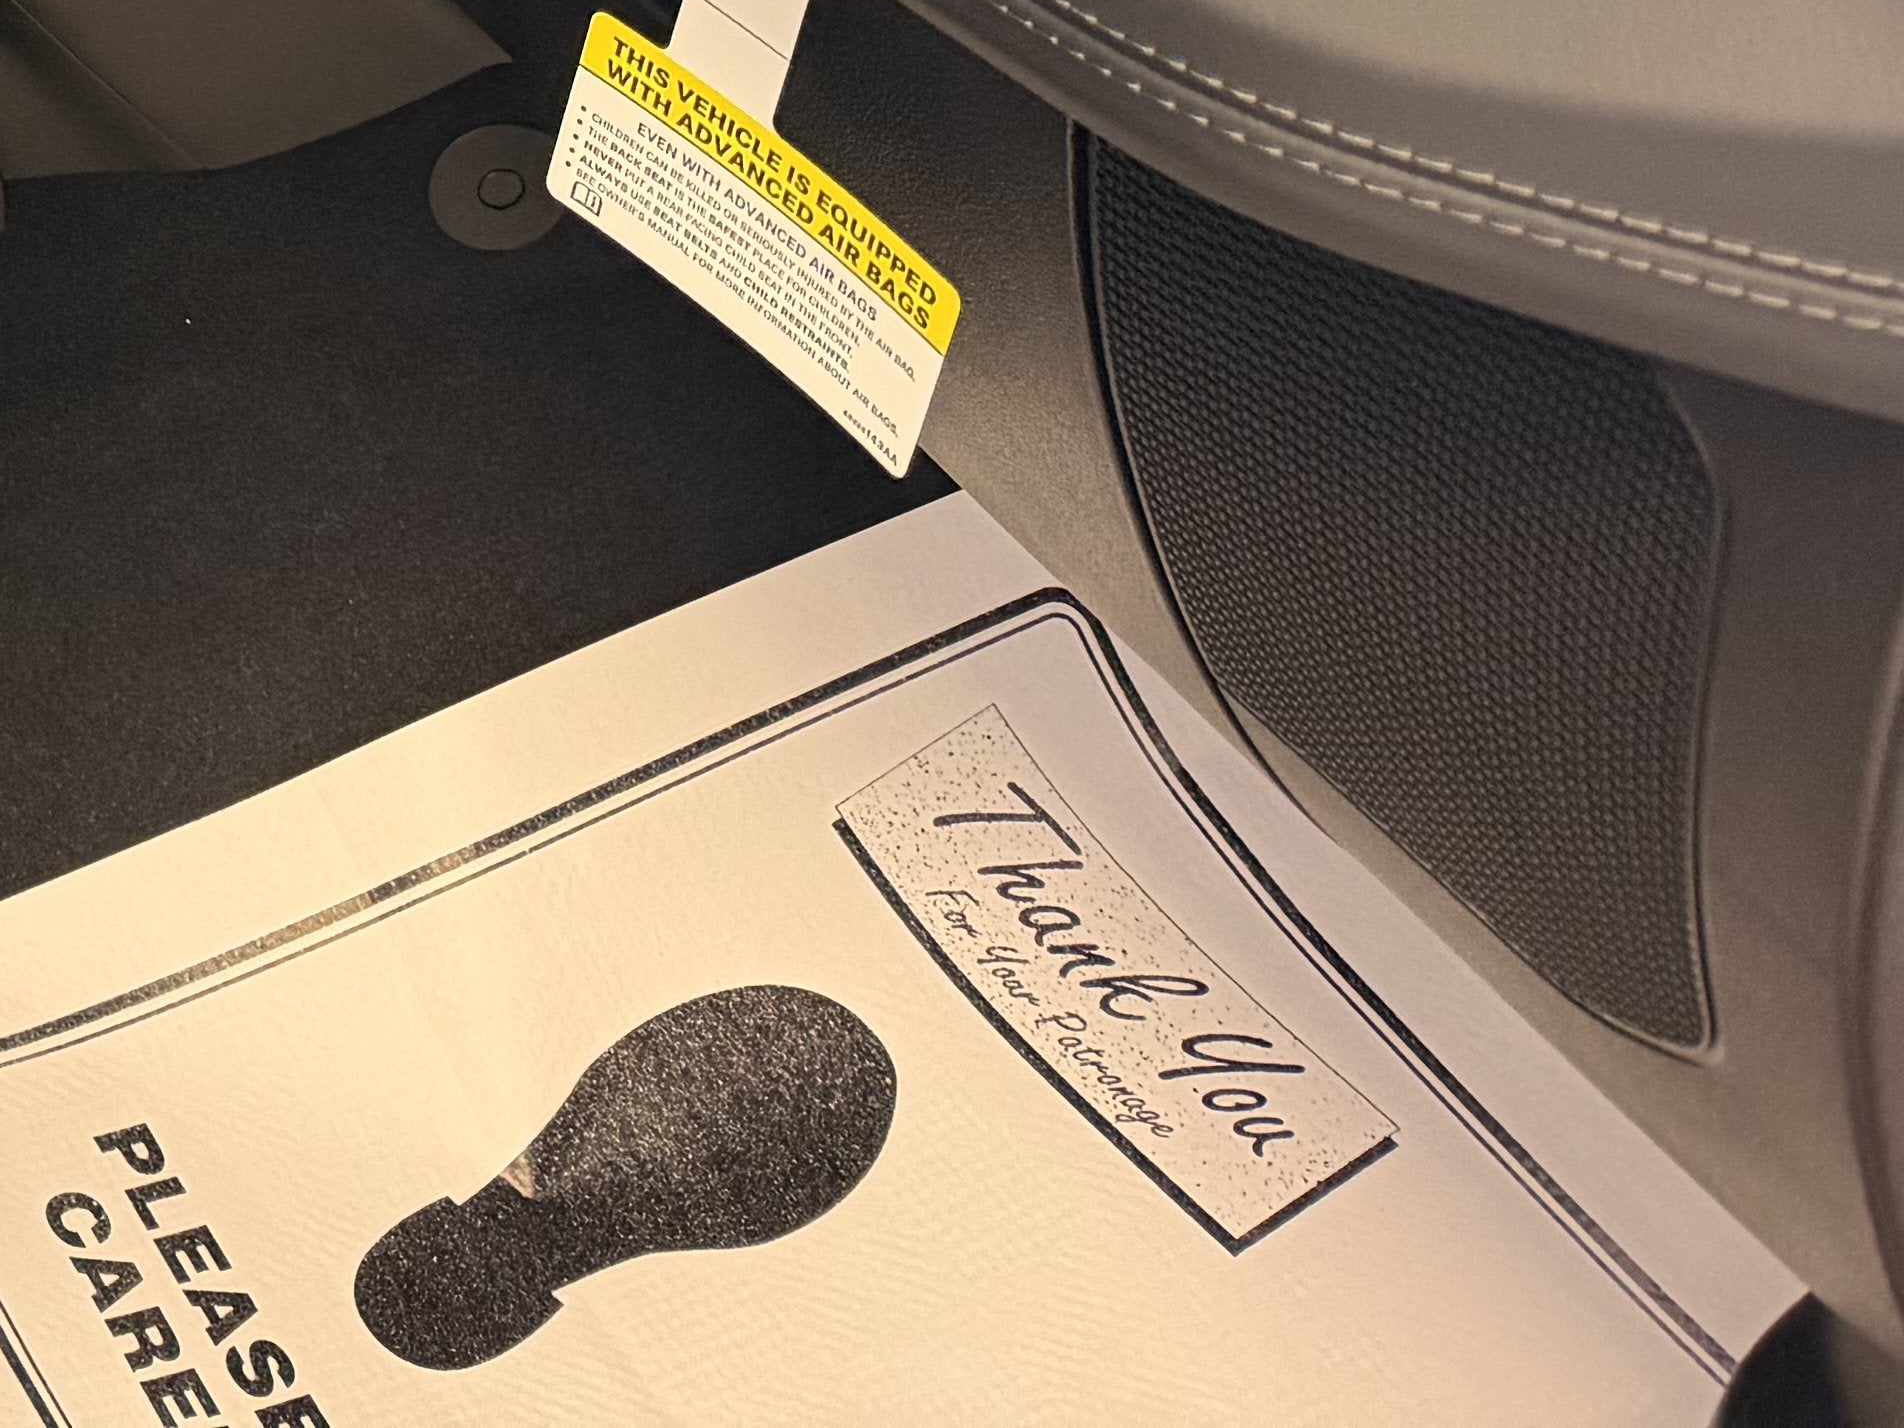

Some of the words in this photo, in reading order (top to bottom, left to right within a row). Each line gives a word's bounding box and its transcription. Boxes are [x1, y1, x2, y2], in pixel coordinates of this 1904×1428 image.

[576, 168, 596, 187] SEE
[647, 218, 691, 257] MANUAL
[693, 253, 713, 274] FOR
[715, 270, 746, 300] MORE
[747, 296, 816, 360] INFORMATION
[817, 357, 851, 390] ABOUT
[852, 388, 869, 409] AIR
[580, 155, 628, 193] ALWAYS
[630, 189, 651, 210] USE
[653, 206, 682, 232] SEAT
[684, 229, 718, 260] BELTS
[719, 258, 742, 279] AND
[744, 276, 779, 309] CHILD
[584, 140, 623, 172] NEVER
[624, 168, 645, 188] PUT
[647, 186, 654, 196] A
[725, 244, 756, 273] CHILD
[758, 270, 782, 294] SEAT
[784, 292, 796, 307] IN
[798, 304, 817, 325] THE
[589, 126, 608, 146] THE
[610, 142, 642, 171] BACK
[644, 166, 673, 191] SEAT
[675, 187, 685, 202] IS
[687, 196, 707, 219] THE
[709, 214, 752, 251] SAFEST
[752, 248, 785, 281] PLACE
[786, 275, 807, 299] FOR
[592, 113, 644, 154] CHILDREN
[646, 151, 669, 172] CAN
[670, 168, 685, 184] BE
[686, 179, 722, 212] KILLED
[723, 208, 738, 225] OR
[740, 221, 796, 270] SERIOUSLY
[797, 267, 838, 308] INJURED
[840, 304, 854, 321] BY
[856, 316, 875, 342] THE
[876, 338, 893, 358] AIR
[608, 59, 672, 117] WITH
[676, 113, 814, 225] ADVANCED
[818, 224, 860, 268] AIR
[865, 261, 930, 330] BAGS
[613, 36, 670, 88] THIS
[677, 80, 782, 174] VEHICLE
[786, 165, 811, 196] IS
[816, 189, 937, 306] EQUIPPED
[637, 123, 678, 159] EVEN
[682, 153, 721, 192] WITH
[724, 188, 807, 259] ADVANCED
[809, 257, 835, 285] AIR
[837, 279, 877, 322] BAGS
[925, 888, 980, 940] For
[975, 943, 1041, 1010] Your
[1035, 1011, 1180, 1141] Patronage
[933, 781, 1210, 1022] Thank
[1157, 1033, 1306, 1158] You
[45, 1191, 231, 1428] CARE
[92, 1122, 332, 1428] PLEASE
